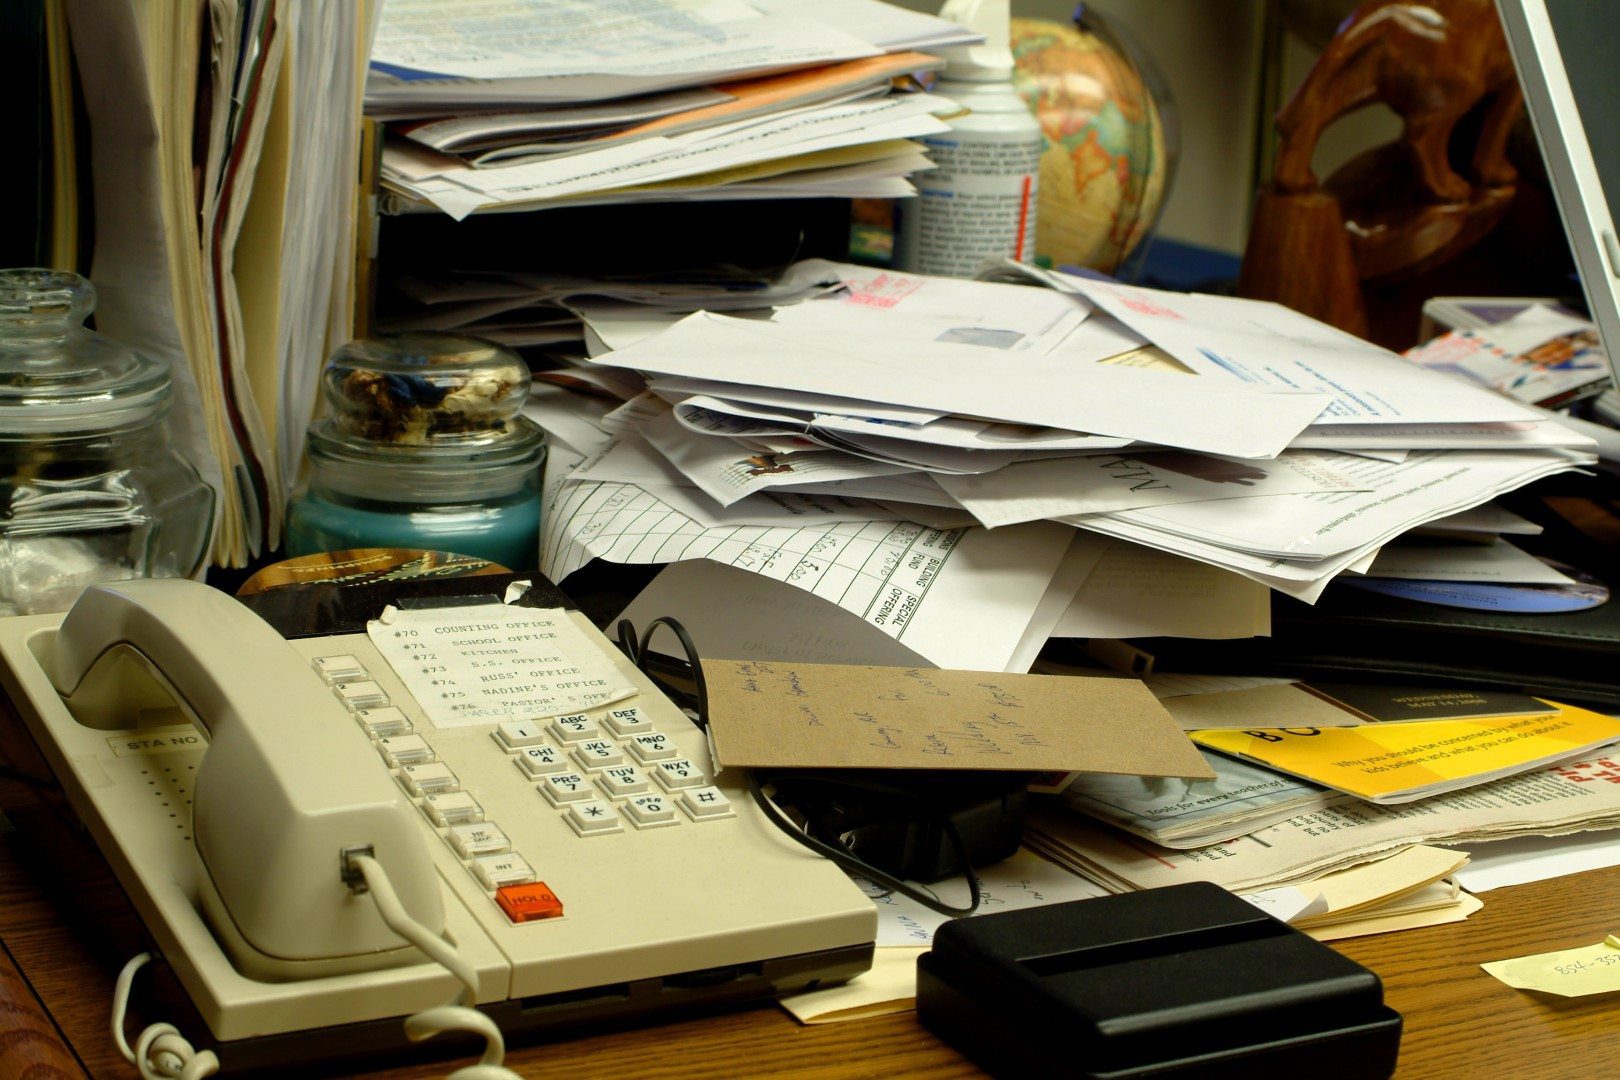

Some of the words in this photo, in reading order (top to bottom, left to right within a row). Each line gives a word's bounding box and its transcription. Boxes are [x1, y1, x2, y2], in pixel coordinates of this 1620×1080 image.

[908, 552, 926, 570] FUND
[916, 558, 940, 588] BUILDING
[874, 588, 903, 626] OFFERING
[892, 595, 917, 626] SPECIAL
[394, 629, 419, 638] #70
[434, 623, 499, 635] COUNTING
[506, 620, 555, 629] OFFICE
[452, 637, 502, 647] SCHOOL
[507, 632, 558, 642] OFFICE
[461, 648, 519, 657] KITCHEN
[421, 665, 447, 674] #73
[471, 659, 503, 668] S.S.
[512, 656, 562, 664] OFFICE
[480, 671, 518, 683] RUSS'
[530, 667, 581, 678] OFFICE
[441, 691, 466, 699] #75
[482, 684, 549, 696] NADINE'S
[556, 679, 607, 690] OFFICE
[612, 708, 638, 719] DEF
[560, 714, 588, 727] ABC
[626, 716, 640, 724] 3
[572, 723, 586, 731] 2
[518, 729, 527, 738] 1
[126, 739, 166, 750] STA
[170, 736, 199, 745] NO
[636, 734, 666, 745] MNO
[1332, 758, 1366, 768] Why
[1366, 755, 1387, 765] you
[1386, 746, 1421, 759] should
[1439, 730, 1493, 746] concerned
[1506, 719, 1534, 730] what
[585, 740, 611, 751] JKL
[653, 743, 664, 751] 6
[1389, 757, 1426, 769] believe
[1427, 750, 1450, 761] and
[1450, 744, 1479, 756] what
[1479, 740, 1499, 751] you
[1498, 736, 1517, 744] can
[1517, 731, 1534, 740] do
[1533, 723, 1562, 735] about
[528, 747, 555, 758] GHI
[597, 749, 610, 757] 5
[662, 760, 692, 772] WXY
[607, 767, 635, 778] TUV
[677, 769, 689, 777] 9
[551, 774, 581, 785] PRS
[622, 776, 635, 784] 8
[566, 783, 577, 791] 7
[1145, 805, 1178, 816] Tools
[1177, 801, 1195, 811] for
[1197, 792, 1229, 805] every
[1227, 782, 1269, 796] teacher
[1268, 779, 1283, 788] of
[647, 804, 661, 812] 0
[512, 893, 552, 906] HOLD
